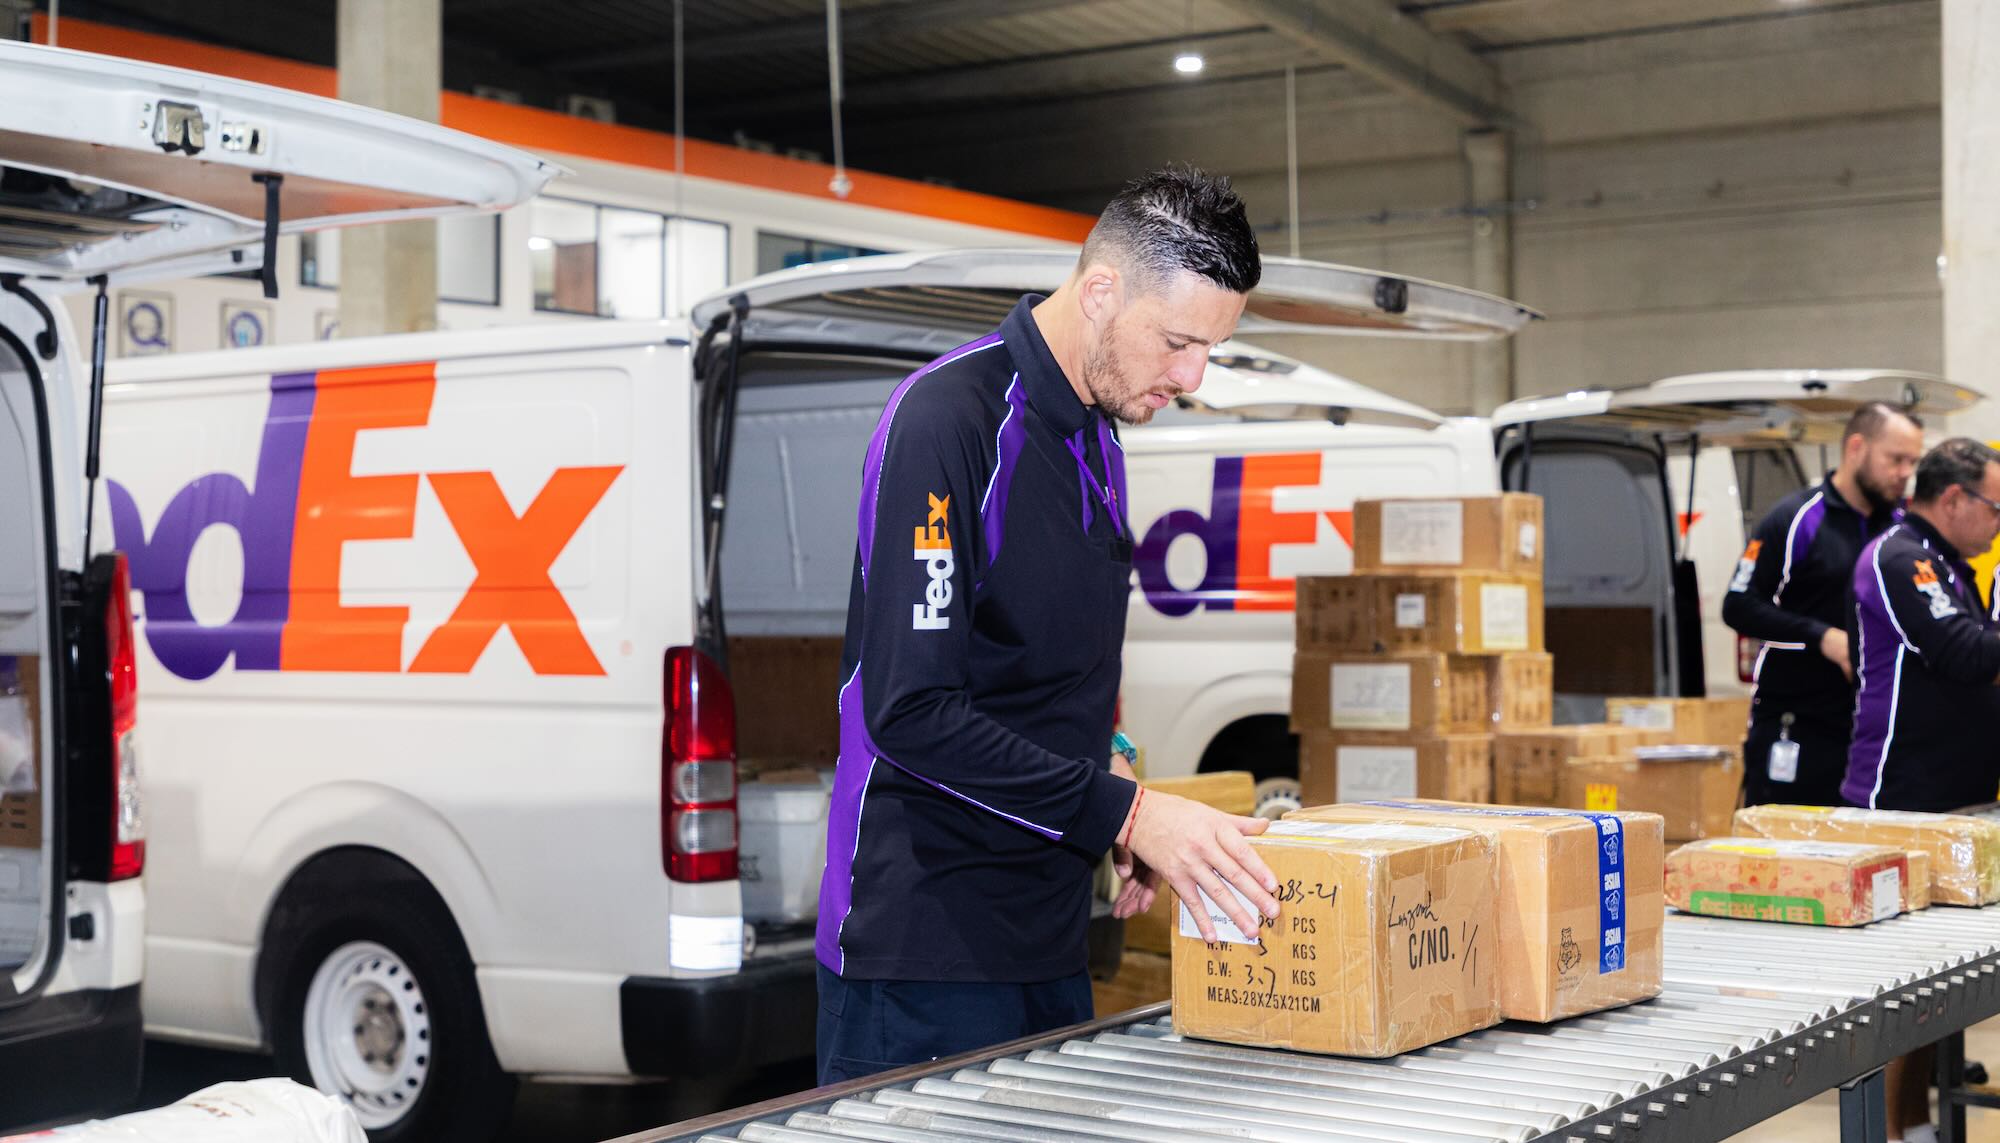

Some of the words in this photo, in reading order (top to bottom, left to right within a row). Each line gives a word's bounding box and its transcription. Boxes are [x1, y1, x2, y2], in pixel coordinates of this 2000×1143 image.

[912, 491, 955, 630] FedEx
[1292, 916, 1316, 934] PCS
[1292, 943, 1316, 960] KGS
[1409, 926, 1455, 970] C/NO.
[1207, 960, 1232, 977] G.W:
[1292, 969, 1316, 986] KGS
[1207, 986, 1320, 1013] MEAS:28X25X21CM
